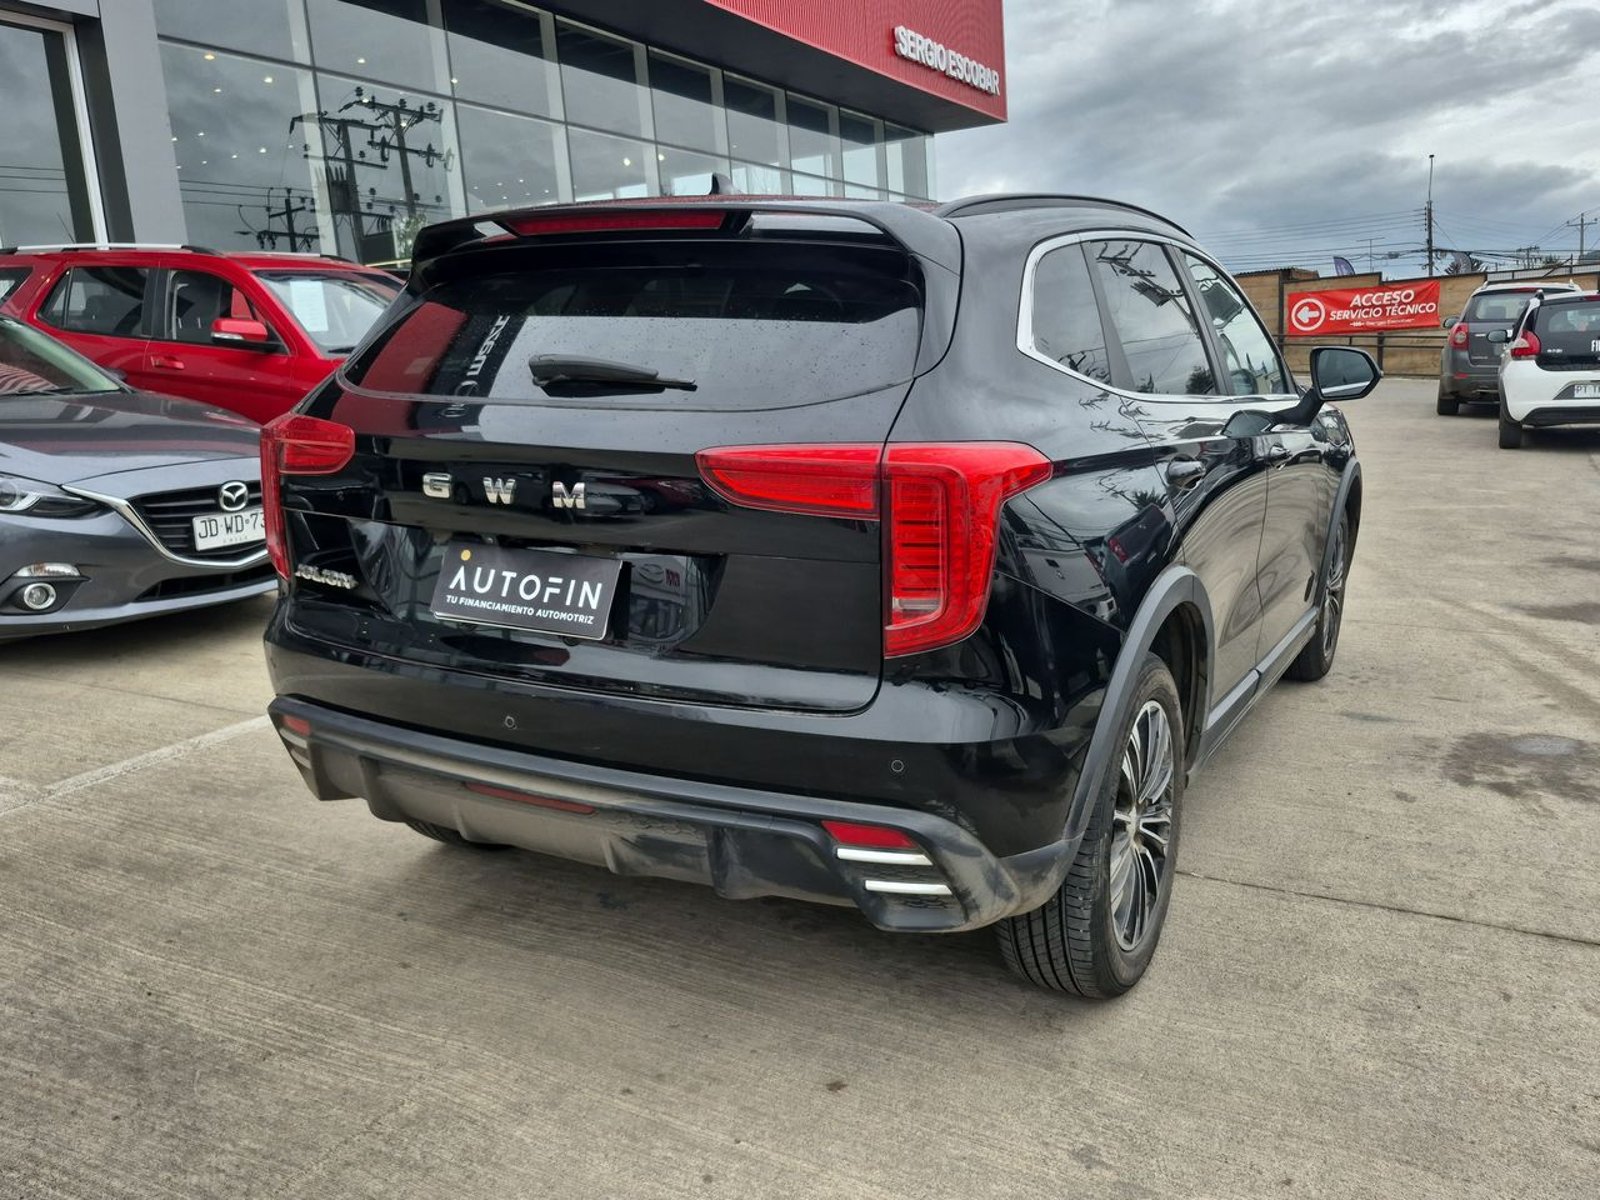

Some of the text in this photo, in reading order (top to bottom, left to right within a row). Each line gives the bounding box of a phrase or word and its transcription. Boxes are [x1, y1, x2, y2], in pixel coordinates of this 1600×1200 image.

[894, 25, 1000, 96] SERGIO ESCOBAR
[1329, 302, 1437, 321] SERVICIO TÉCNICO
[1350, 289, 1415, 307] ACCESO
[422, 472, 586, 509] GWM
[449, 565, 602, 610] AUTOFIN
[446, 595, 595, 625] TU FINANCIAMIENTO AUTOMOTRIZ
